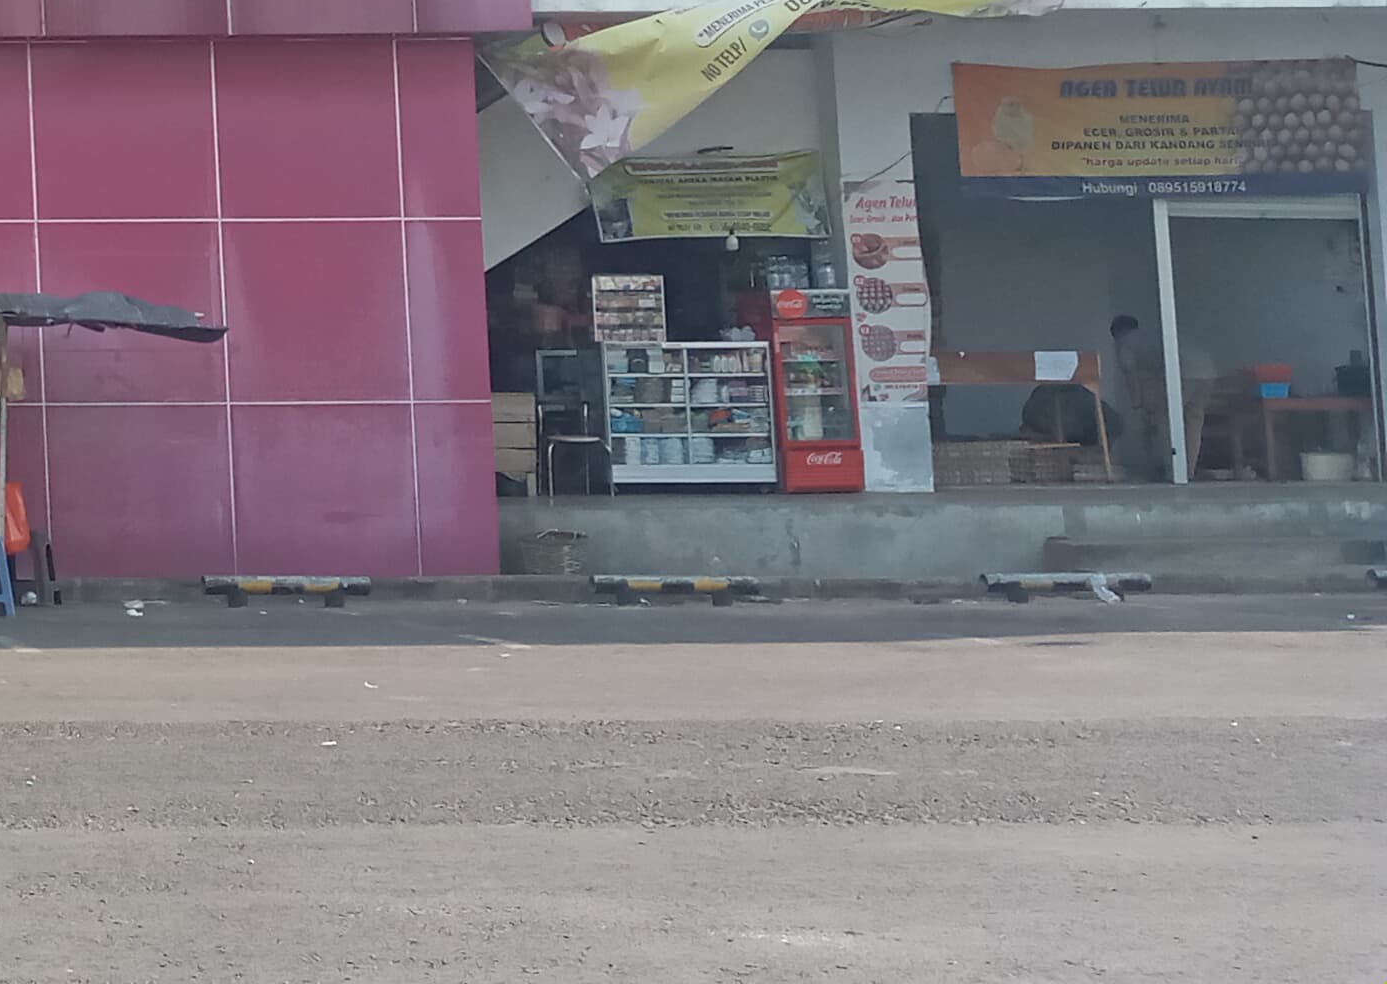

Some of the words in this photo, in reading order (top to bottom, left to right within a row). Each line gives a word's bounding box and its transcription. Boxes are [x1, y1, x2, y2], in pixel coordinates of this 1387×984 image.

[700, 62, 722, 83] NO
[1059, 79, 1117, 98] AGEN
[1126, 78, 1186, 97] TELUR
[1119, 114, 1190, 124] MENERIMA
[1125, 127, 1175, 137] GROSIR
[1051, 141, 1111, 151] DIPANEN
[1116, 140, 1146, 150] DARI
[1150, 140, 1215, 150] KANDANG
[1127, 157, 1167, 168] update
[1173, 156, 1211, 168] setiap
[1082, 183, 1138, 195] Hubungi
[855, 196, 888, 213] Agen
[806, 451, 844, 465] Coca-Cola
